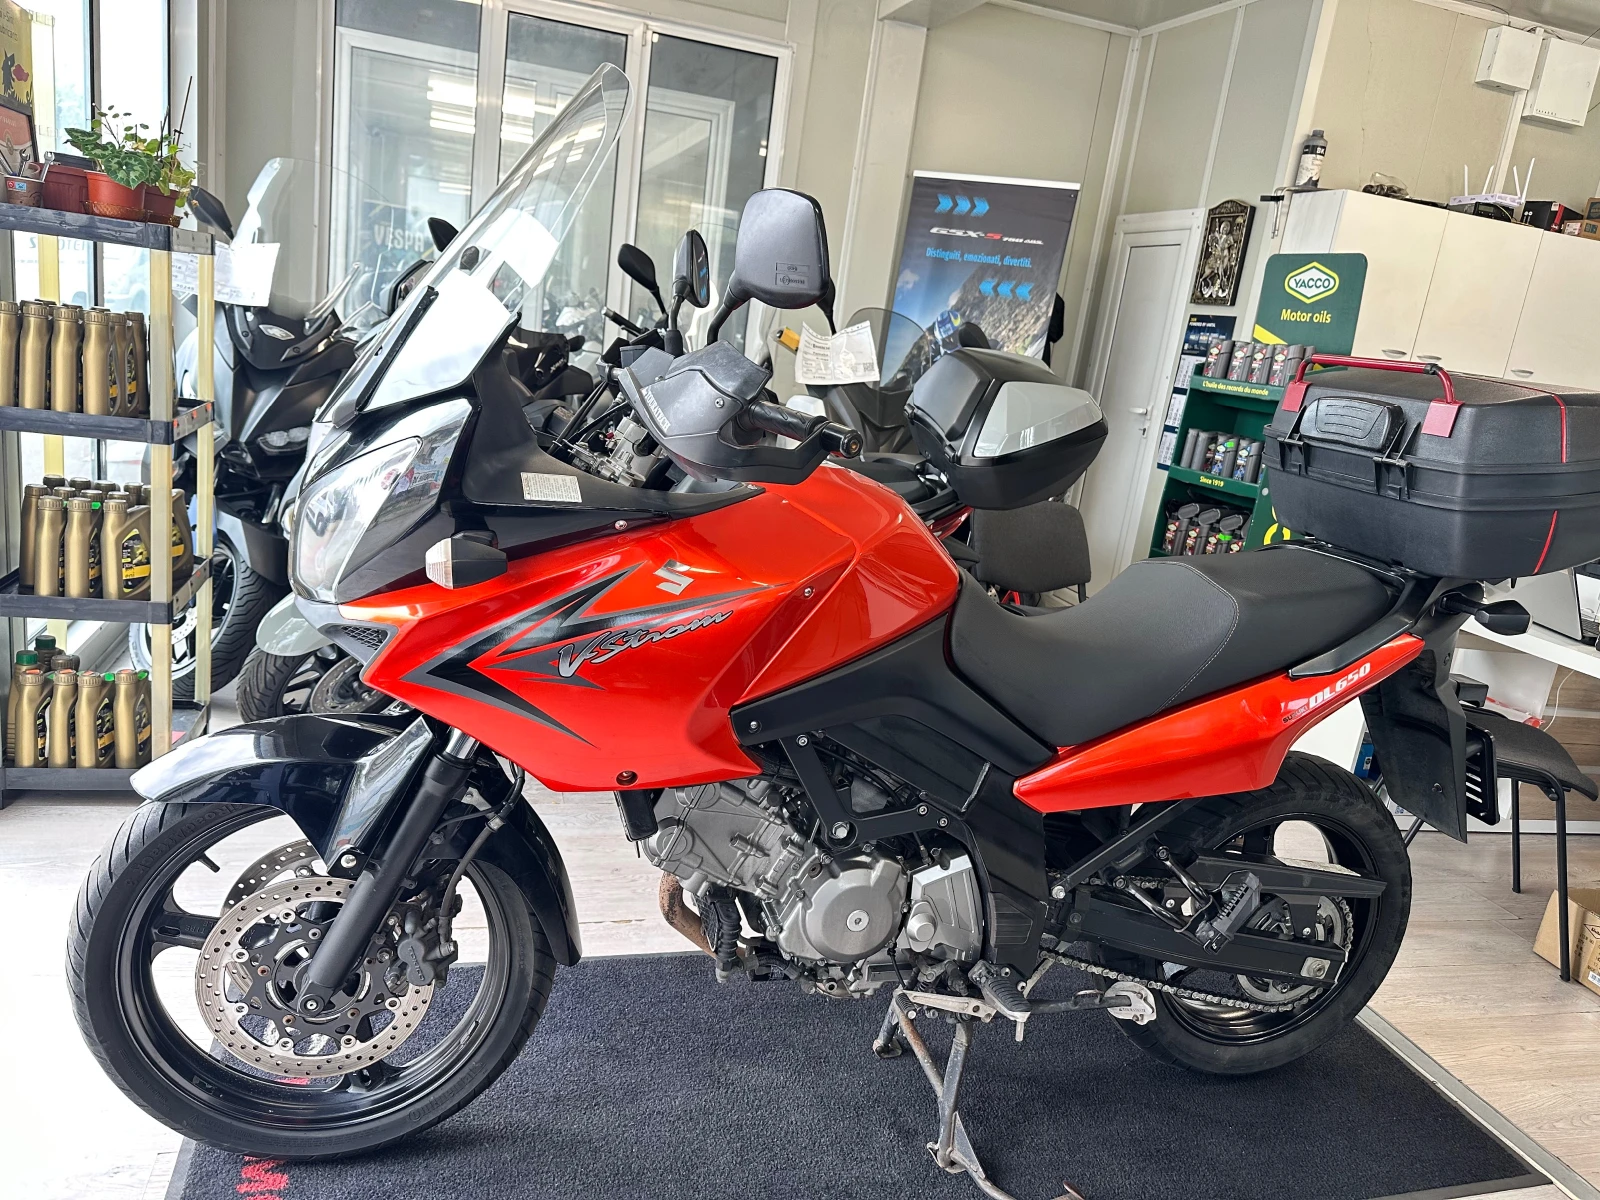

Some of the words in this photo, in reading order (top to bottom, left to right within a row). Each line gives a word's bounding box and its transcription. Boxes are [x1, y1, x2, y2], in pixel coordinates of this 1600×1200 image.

[929, 226, 1003, 240] GSX-S
[925, 247, 962, 262] Distinguiti,
[963, 252, 1002, 267] emozionati,
[1003, 256, 1032, 268] divertiti.
[1293, 277, 1331, 289] YACCO
[1280, 308, 1312, 322] Motor
[1312, 310, 1332, 323] oils
[1202, 380, 1217, 389] L'huile
[1226, 384, 1244, 393] records
[1244, 385, 1251, 393] du
[1251, 387, 1269, 396] monde
[643, 386, 671, 433] TOURATECH
[1200, 475, 1212, 485] Since
[1212, 478, 1224, 488] 1919
[558, 610, 733, 678] V-Strom
[1309, 662, 1371, 708] DL650
[408, 945, 425, 981] TOKICO
